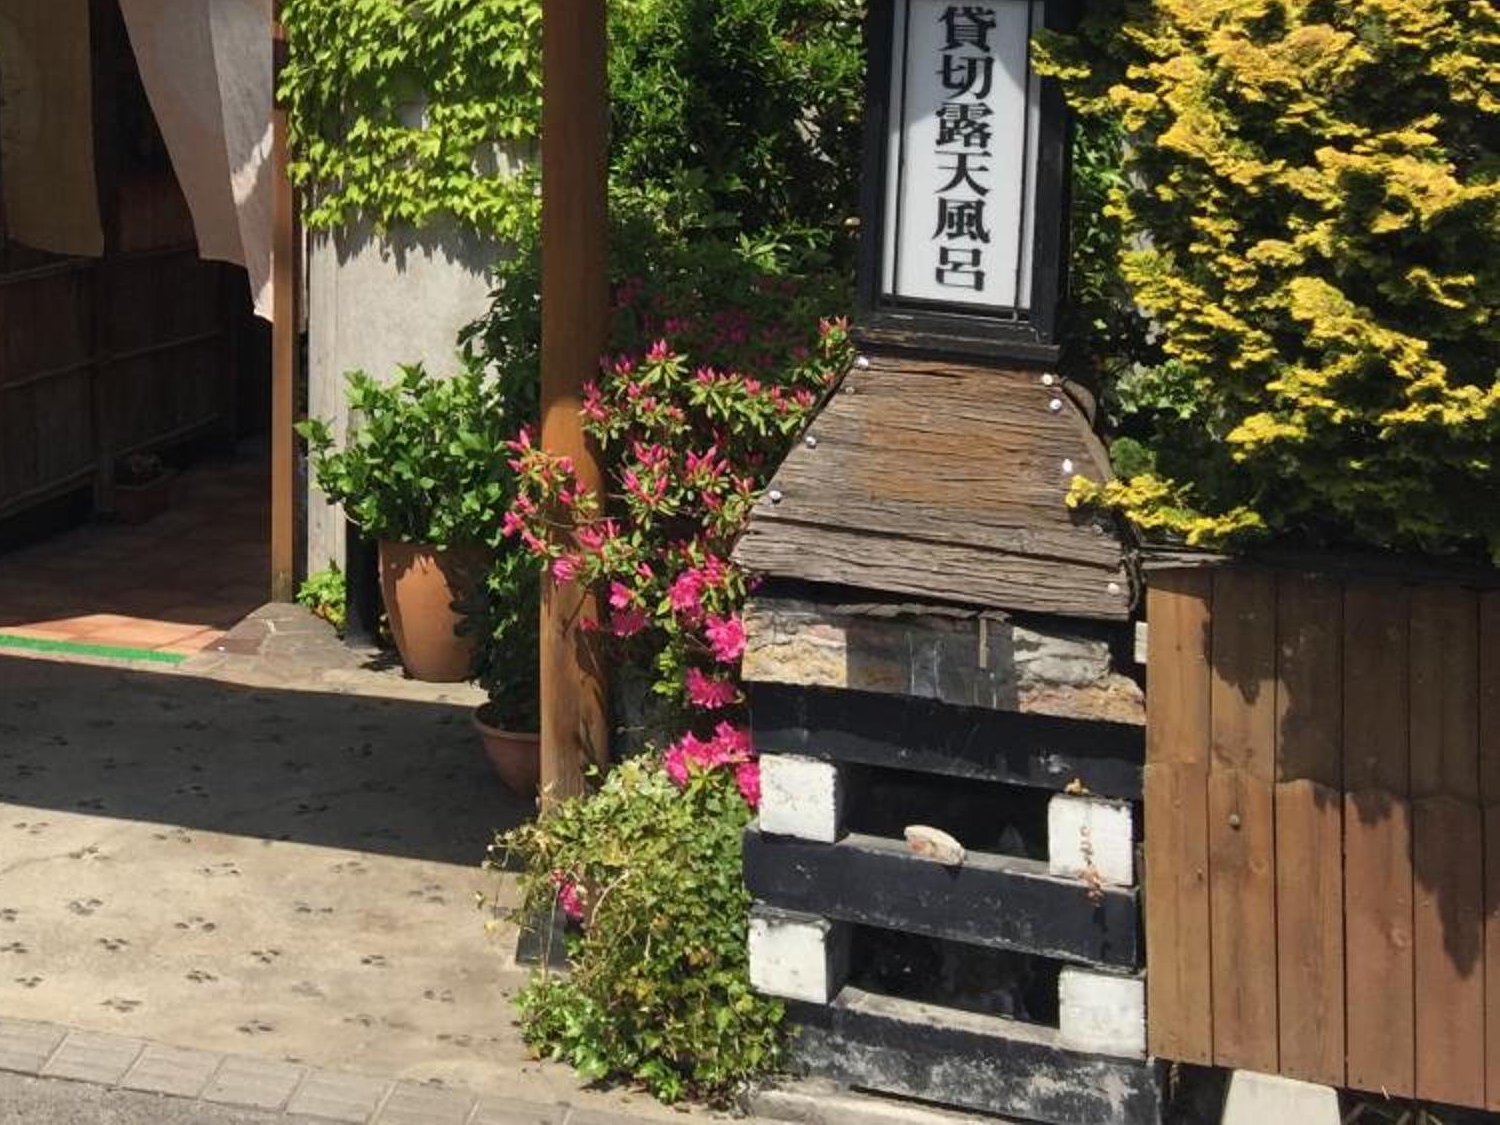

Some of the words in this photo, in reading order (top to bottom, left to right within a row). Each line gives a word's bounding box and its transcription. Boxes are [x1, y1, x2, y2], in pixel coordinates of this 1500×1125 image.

[932, 5, 996, 292] 貸切露天風呂
